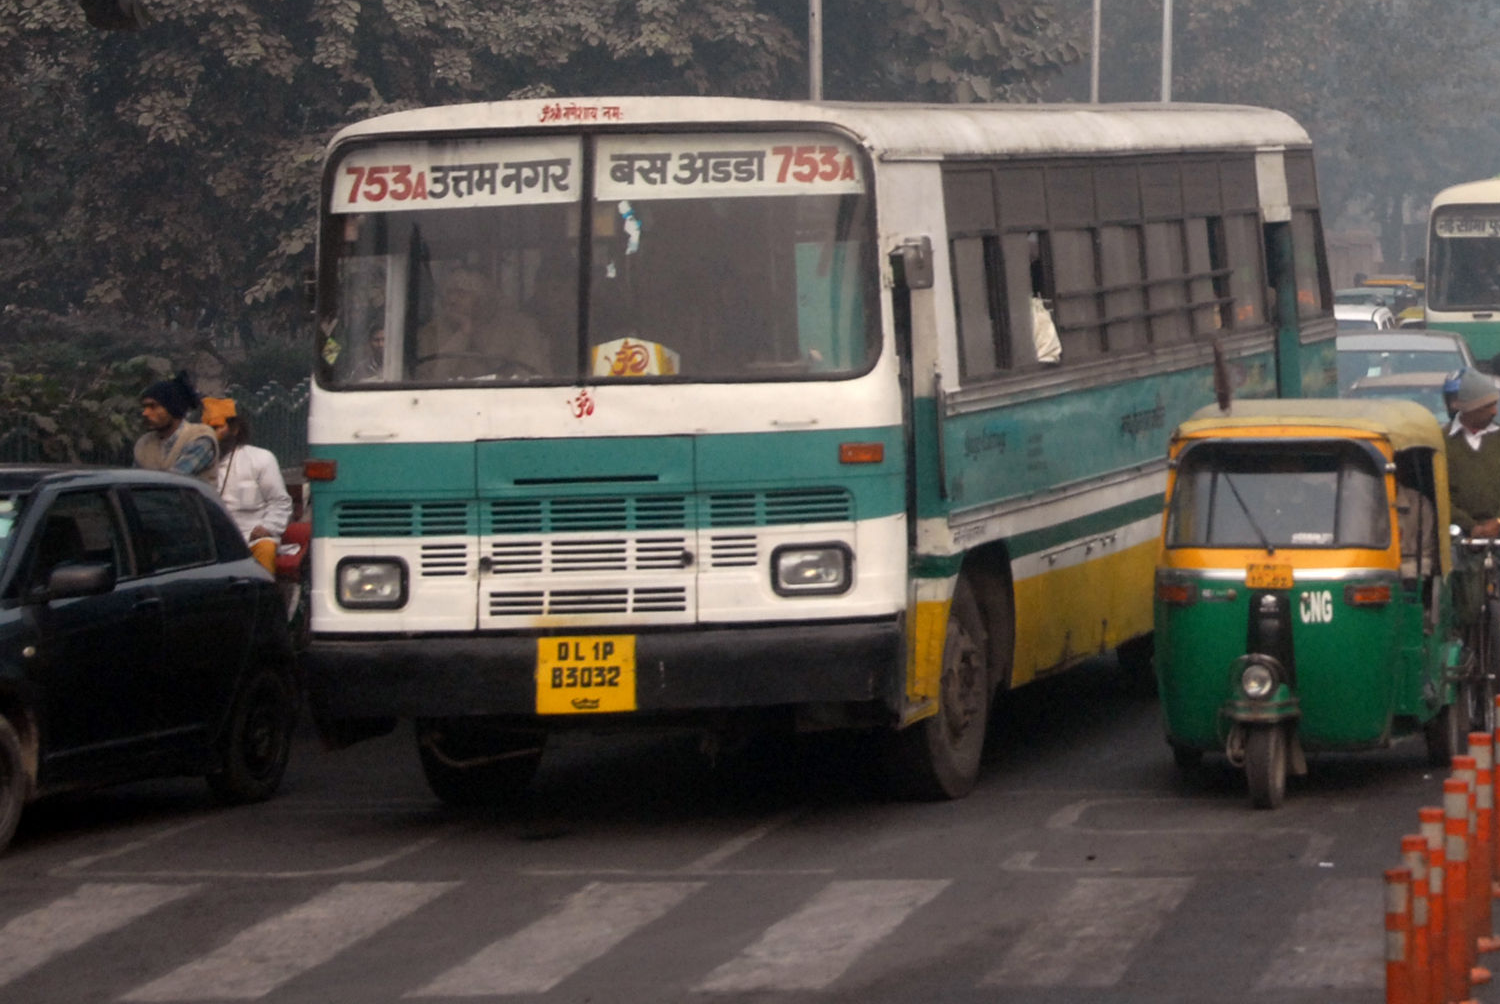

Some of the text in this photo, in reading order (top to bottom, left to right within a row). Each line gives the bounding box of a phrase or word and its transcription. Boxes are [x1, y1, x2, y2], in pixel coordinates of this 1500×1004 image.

[346, 158, 572, 204] 753A उत्तम नगर
[610, 152, 672, 185] बस
[772, 146, 856, 184] 753A
[1300, 590, 1333, 624] CNG
[551, 665, 621, 689] B3032
